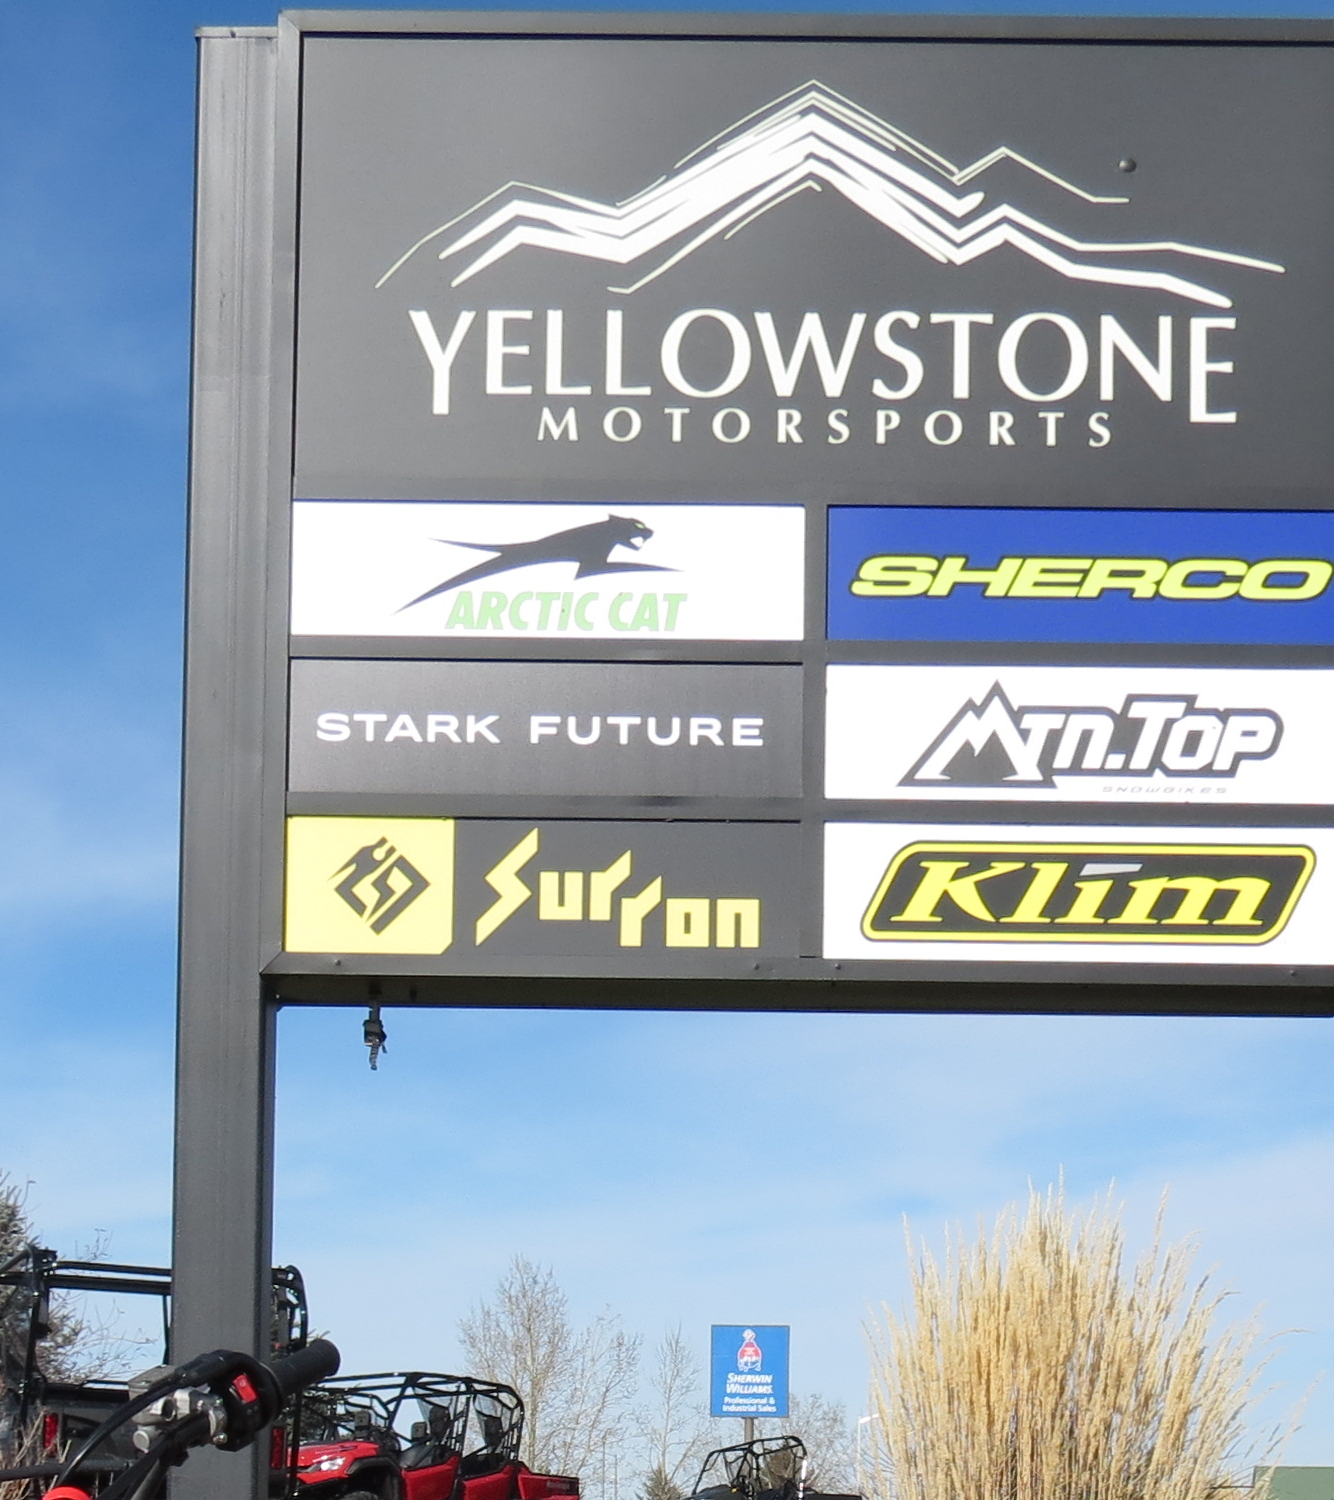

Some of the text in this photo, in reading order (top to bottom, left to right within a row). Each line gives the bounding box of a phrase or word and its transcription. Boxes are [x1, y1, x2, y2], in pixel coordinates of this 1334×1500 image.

[408, 307, 1237, 423] YELLOWSTONE
[537, 405, 1113, 447] MOTORSPORTS
[444, 590, 688, 632] ARCTIC CAT
[315, 712, 765, 748] STARK FUTURE
[1102, 786, 1227, 794] SNOWBIKES
[727, 1372, 773, 1384] SHERWIN
[723, 1396, 776, 1404] Professional &
